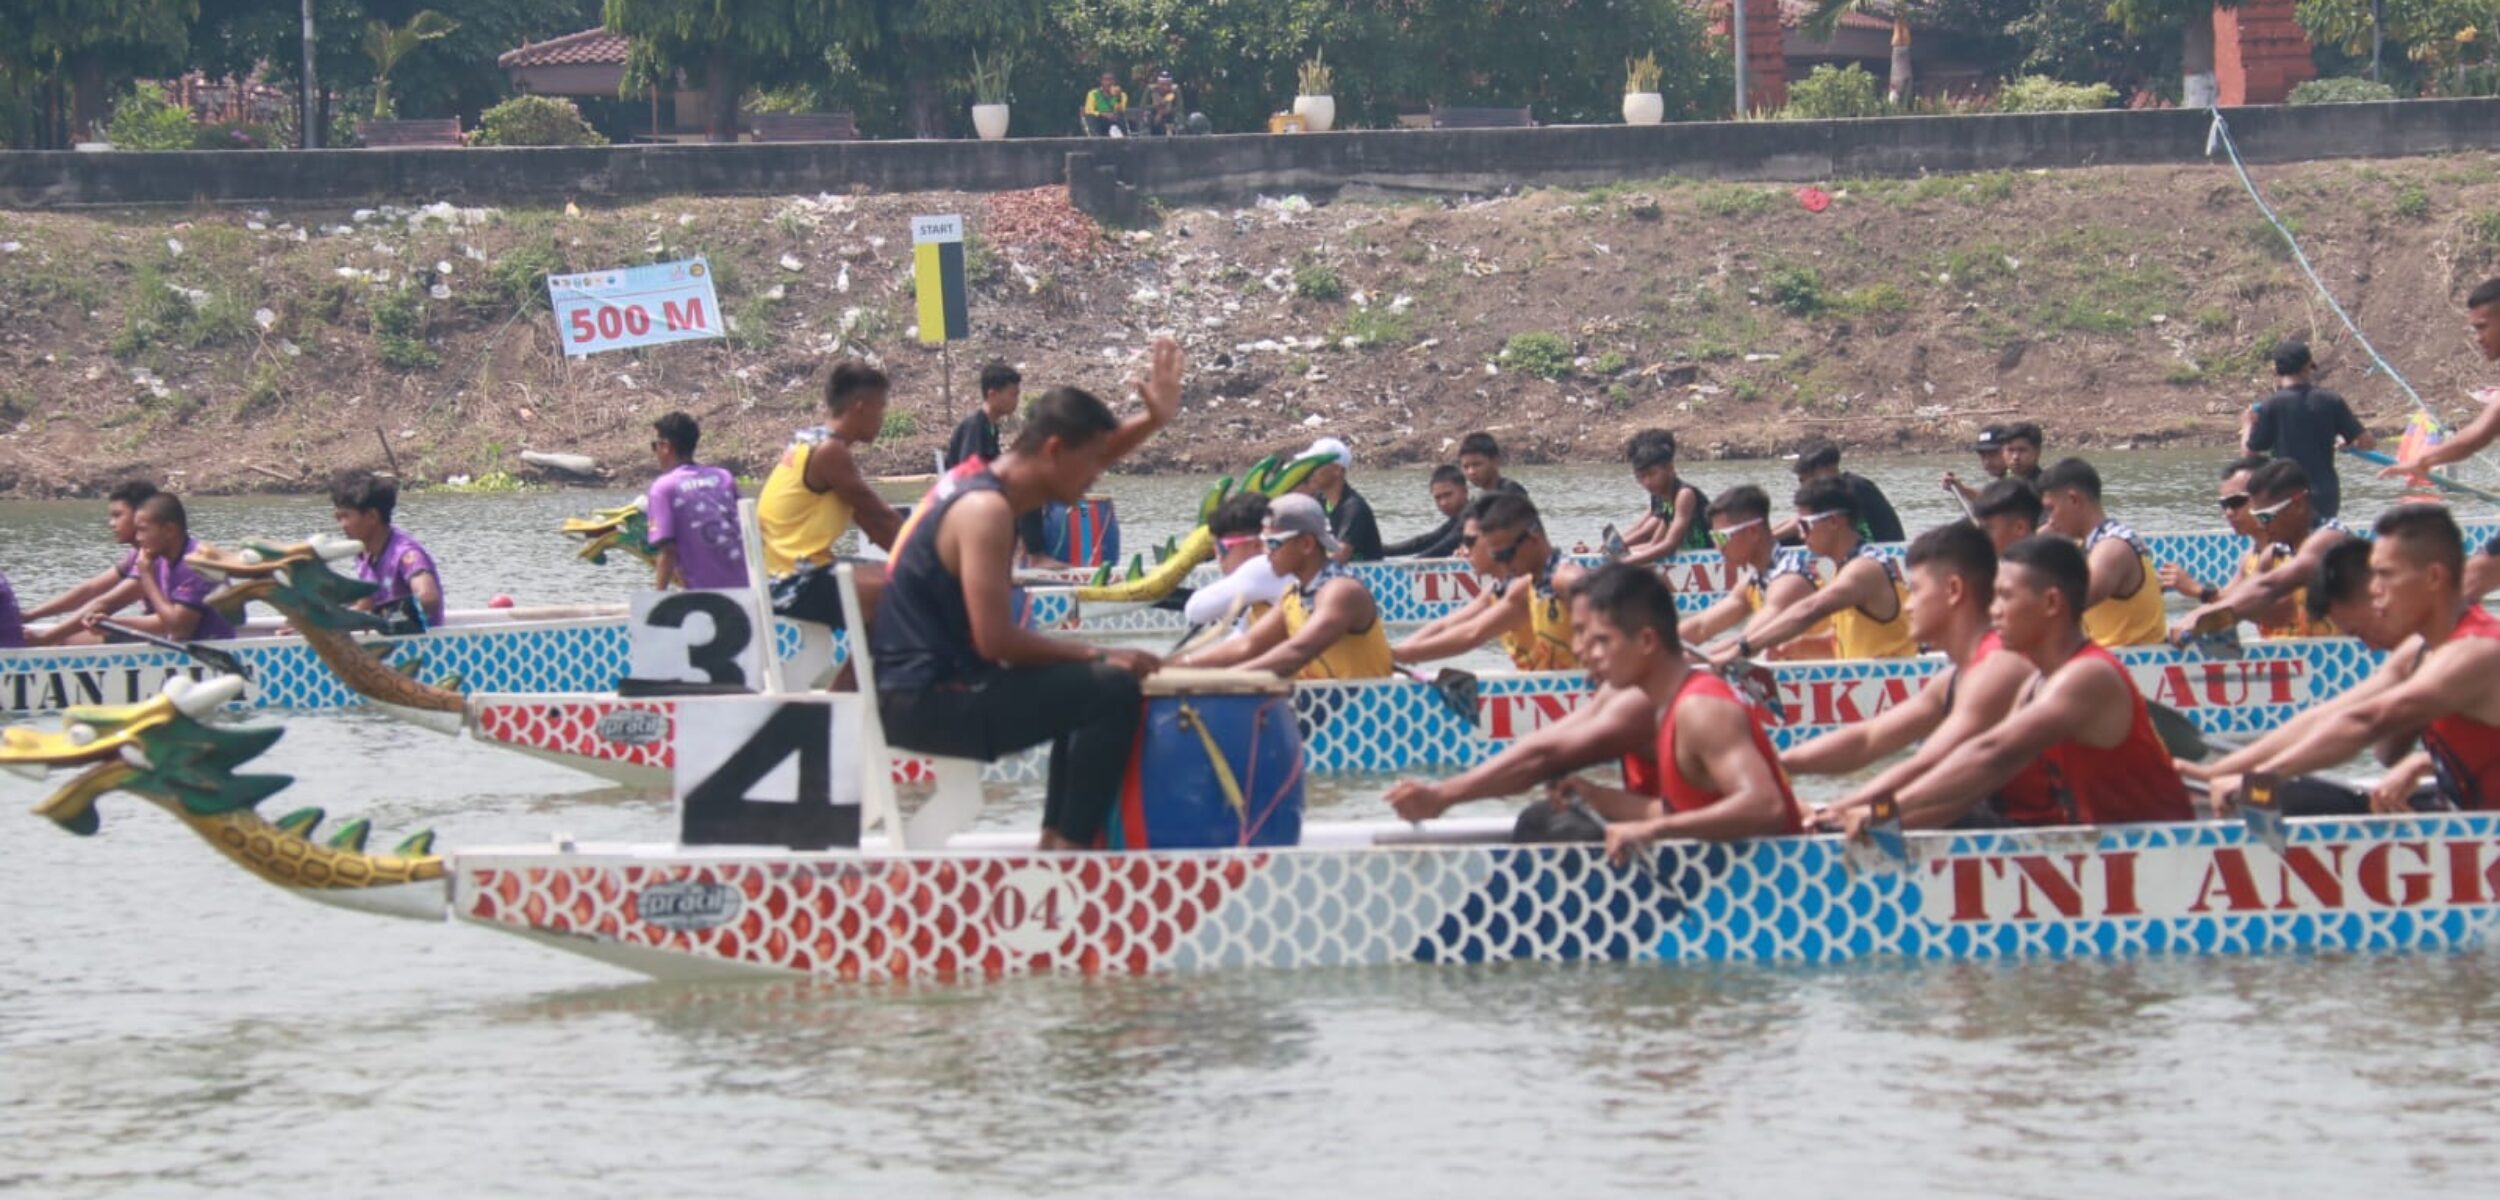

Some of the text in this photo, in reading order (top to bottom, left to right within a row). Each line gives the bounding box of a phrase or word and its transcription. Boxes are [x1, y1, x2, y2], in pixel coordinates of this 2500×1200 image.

[920, 223, 953, 236] START
[570, 296, 706, 343] 500 M
[640, 592, 752, 692] 3
[0, 671, 105, 711] TAN
[1477, 691, 1597, 739] TN
[2154, 660, 2304, 709] AUT
[682, 701, 861, 850] 4
[993, 884, 1066, 931] 04
[1930, 851, 2142, 921] TNI
